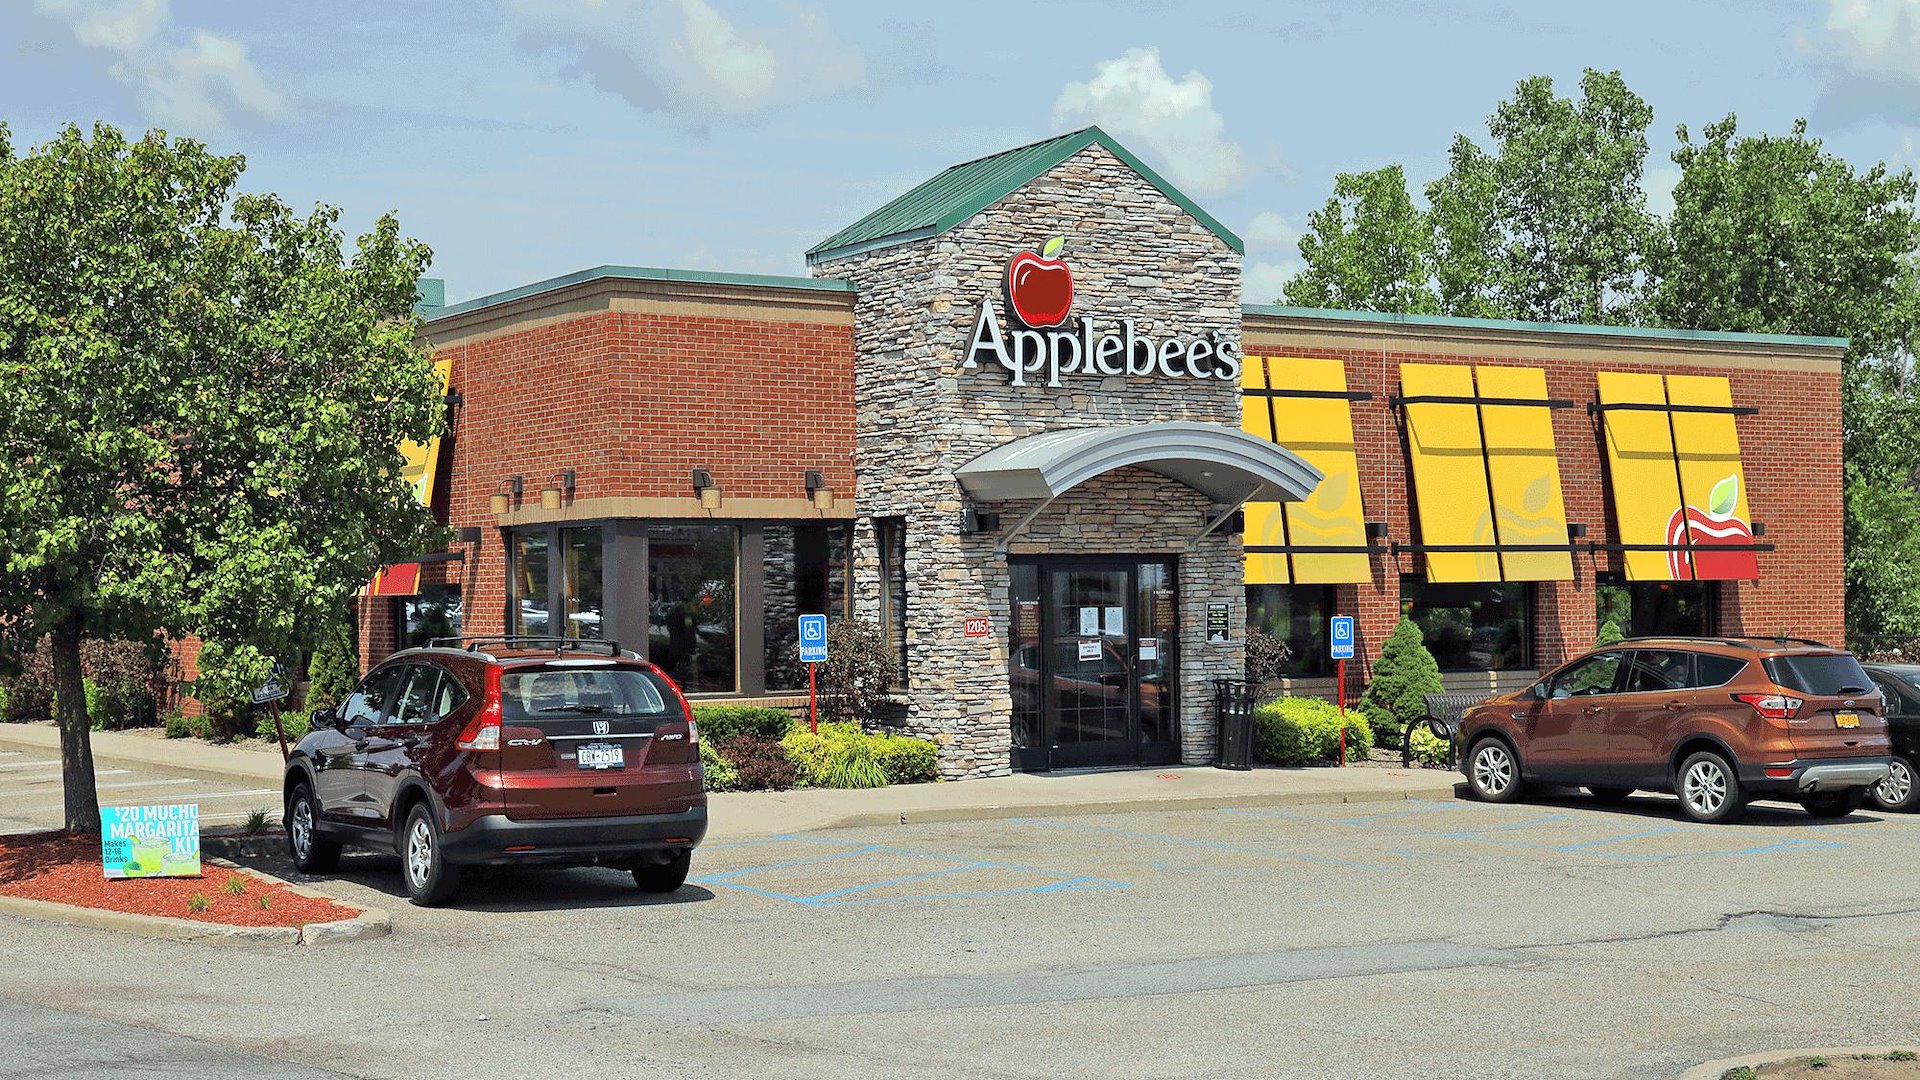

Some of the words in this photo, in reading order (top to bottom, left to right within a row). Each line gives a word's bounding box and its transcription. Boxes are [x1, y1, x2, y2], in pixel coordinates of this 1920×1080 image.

[963, 298, 1239, 387] Applebee's
[966, 620, 986, 633] 1205
[801, 646, 827, 656] PARKING
[1332, 645, 1354, 653] PARKING
[660, 733, 682, 741] AWD
[114, 806, 140, 822] $20
[143, 804, 199, 821] MUCHO
[110, 820, 199, 839] MARGARITA
[175, 836, 199, 854] KIT
[105, 855, 128, 863] Drinks
